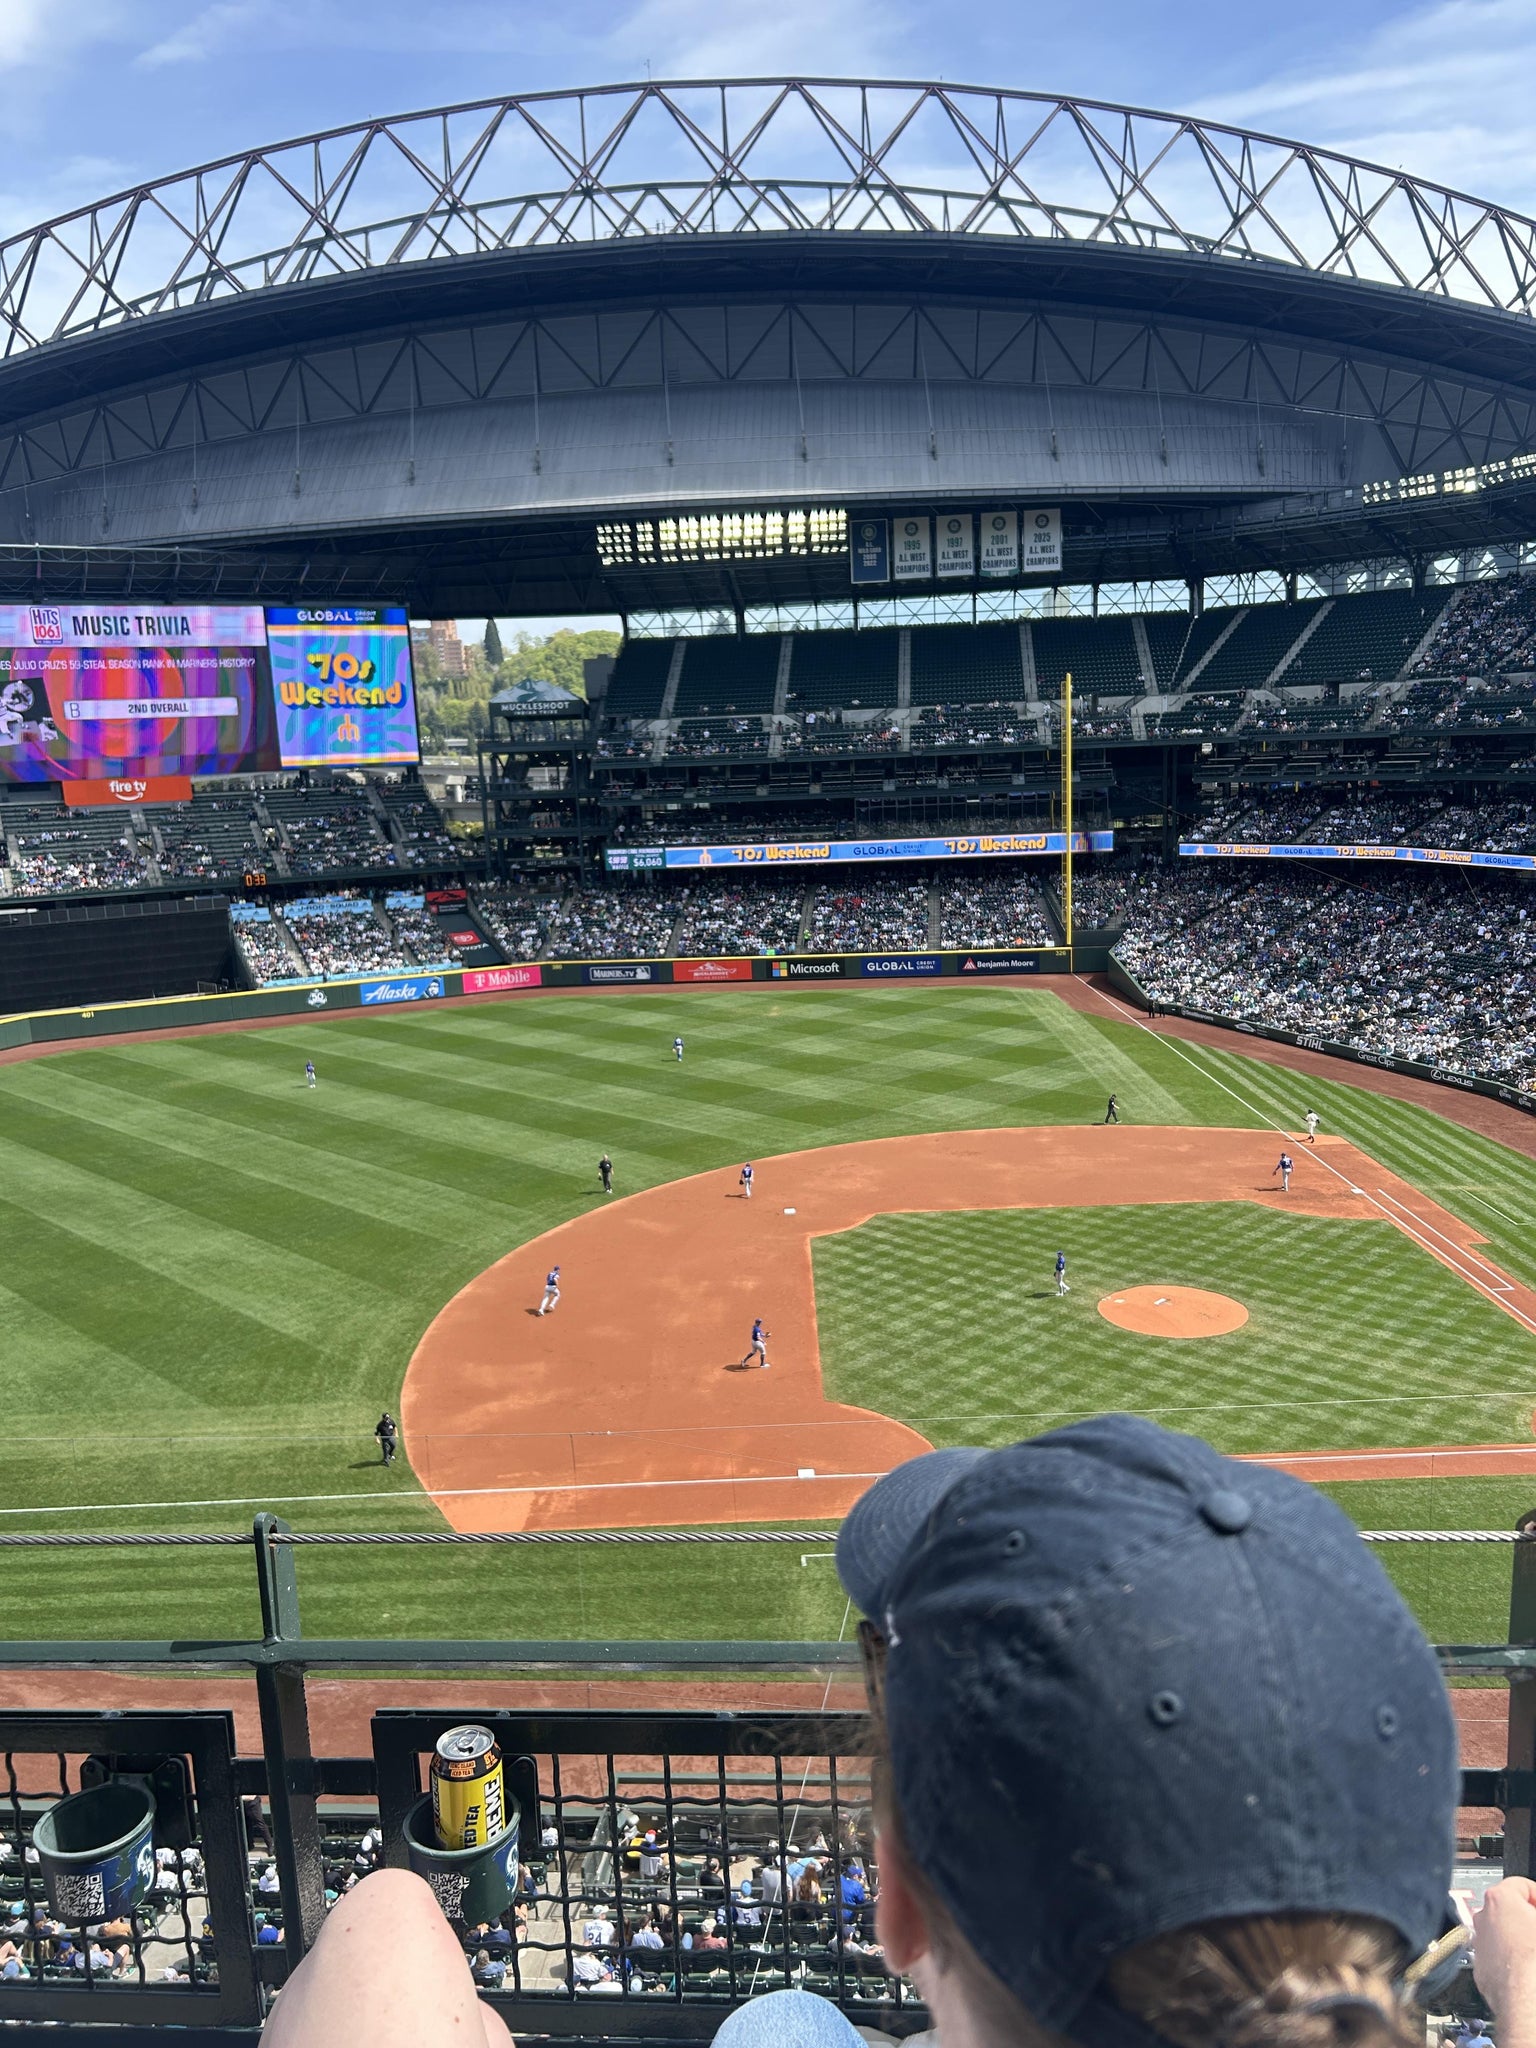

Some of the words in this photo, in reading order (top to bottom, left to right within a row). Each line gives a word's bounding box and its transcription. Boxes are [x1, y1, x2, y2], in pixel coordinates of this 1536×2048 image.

[947, 537, 963, 548] 1997
[991, 534, 1008, 545] 2001
[1033, 532, 1051, 543] 2025
[953, 550, 969, 559] WEST
[997, 547, 1013, 556] WEST
[1041, 545, 1055, 553] WEST
[910, 553, 926, 561] WEST
[1026, 556, 1059, 566] CHAMPIONS
[896, 564, 930, 574] CHAMPIONS
[938, 561, 972, 572] CHAMPIONS
[982, 559, 1017, 569] CHAMPIONS
[297, 610, 352, 621] GLOBAL
[34, 625, 61, 638] 106.1
[72, 616, 130, 636] MUSIC
[135, 616, 191, 636] TRIVIA
[14, 660, 36, 670] JULIO
[39, 660, 67, 670] CRUZ'S
[108, 659, 141, 670] SEASON
[142, 659, 165, 669] RANK
[167, 659, 175, 668] IN
[176, 658, 218, 668] MARINERS
[219, 658, 255, 668] HISTORY?
[280, 682, 403, 706] Weekend
[70, 703, 80, 717] B
[128, 704, 148, 714] 2ND
[150, 702, 189, 713] OVERALL
[501, 702, 570, 711] MUCKLESHOOT
[109, 780, 132, 793] fire
[133, 780, 147, 791] tv
[980, 836, 1046, 851] Weekend
[766, 845, 830, 859] Weekend
[853, 846, 901, 856] GLOBAL
[1234, 845, 1270, 854] Weekend
[1356, 847, 1396, 857] Weekend
[633, 858, 662, 867] $6,060
[1439, 852, 1472, 862] Weekend
[1484, 857, 1510, 865] GLOBAL
[330, 902, 358, 910] SQUAD
[790, 962, 840, 974] Microsoft
[867, 961, 914, 971] GLOBAL
[977, 960, 1009, 968] Benjamin
[488, 969, 530, 986] Mobile
[366, 983, 417, 1001] Alaska
[1296, 1035, 1325, 1051] STIHL
[1357, 1051, 1377, 1063] Great
[1378, 1056, 1395, 1068] Clips
[1442, 1073, 1473, 1087] LEXUS
[465, 1805, 481, 1828] TEA
[743, 1912, 751, 1923] 5
